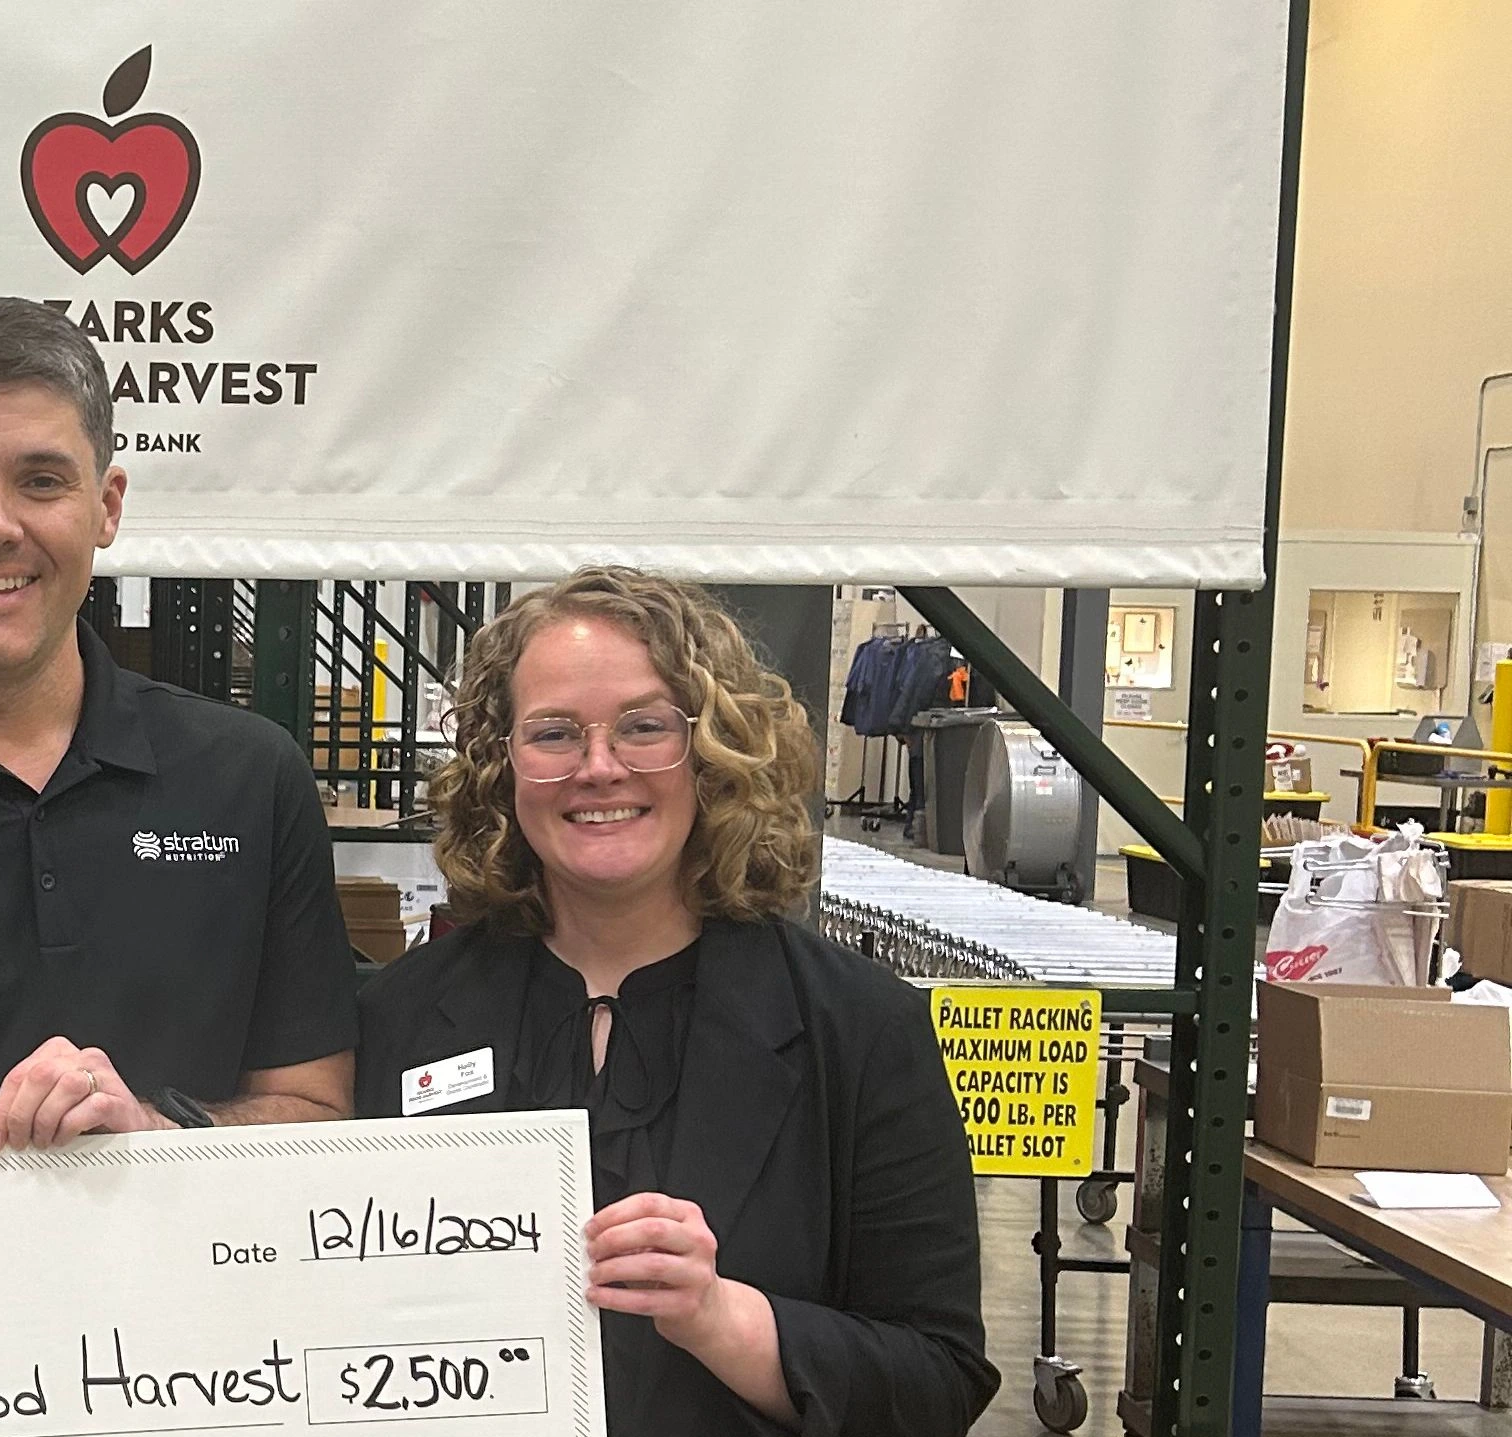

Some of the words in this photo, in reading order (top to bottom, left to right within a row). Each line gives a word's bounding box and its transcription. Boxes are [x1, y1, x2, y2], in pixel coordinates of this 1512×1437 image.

[43, 299, 215, 344] ARKS
[111, 361, 318, 405] ARVEST
[135, 433, 202, 452] BANK
[162, 830, 240, 853] stratum
[939, 1006, 1003, 1030] PALLET
[1009, 1008, 1093, 1032] RACKING
[941, 1038, 1032, 1062] MAXIMUM
[1039, 1040, 1088, 1063] LOAD
[956, 1070, 1047, 1094] CAPACITY
[1052, 1072, 1069, 1095] IS
[960, 1096, 1001, 1125] 500
[1007, 1103, 1036, 1126] LB.
[1043, 1103, 1077, 1127] PER
[967, 1133, 1016, 1157] ALLET
[1022, 1135, 1066, 1158] SLOT
[308, 1196, 542, 1262] 12/16/2024
[212, 1242, 277, 1266] Date
[81, 1327, 301, 1415] Harvest
